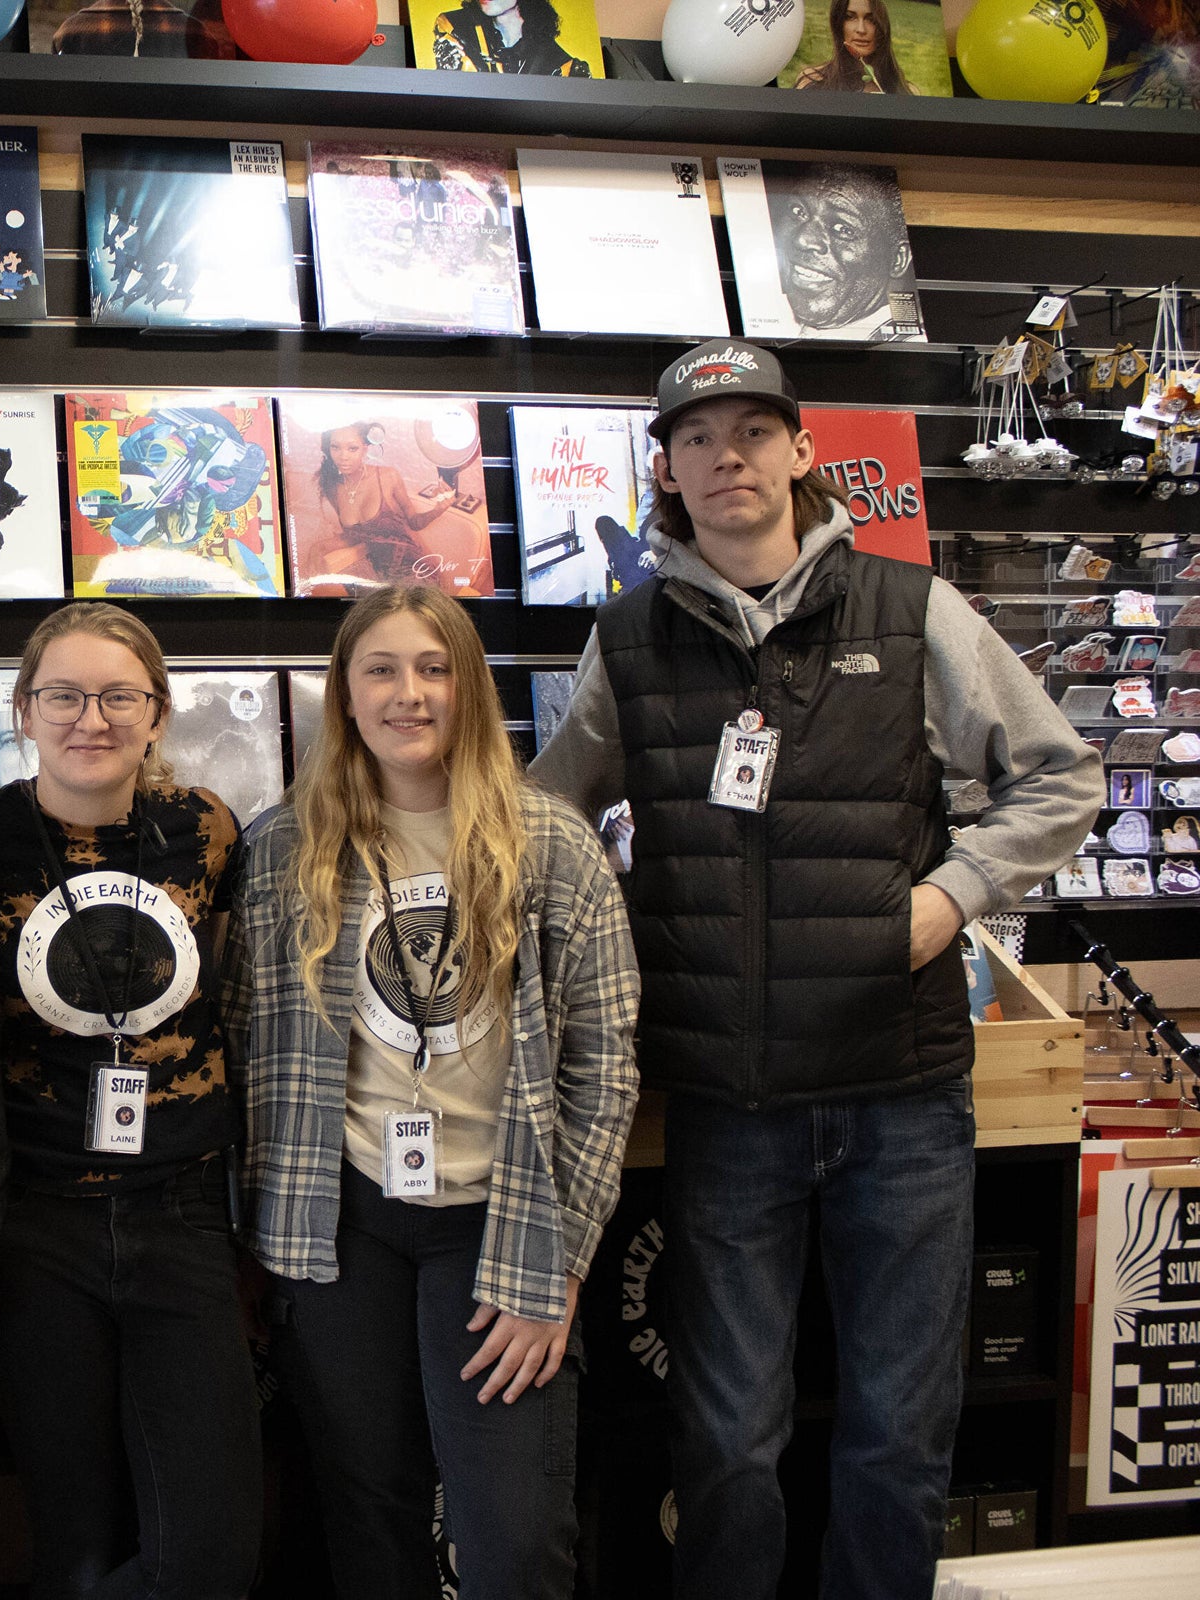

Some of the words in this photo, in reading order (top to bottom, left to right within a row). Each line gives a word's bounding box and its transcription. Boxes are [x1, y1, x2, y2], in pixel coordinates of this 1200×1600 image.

[724, 5, 758, 37] DAY
[1077, 15, 1100, 50] DAY
[236, 145, 250, 154] LEX
[252, 146, 275, 155] HIVES
[245, 155, 269, 163] ALBUM
[724, 162, 758, 170] HOWLIN'
[238, 164, 252, 172] THE
[254, 165, 277, 174] HIVES
[419, 200, 499, 226] union
[480, 227, 498, 235] buzz
[675, 346, 758, 384] Armadillo
[691, 374, 717, 391] Hat
[719, 373, 742, 385] Co.
[531, 462, 615, 494] HUNTER
[411, 553, 460, 579] Over
[1140, 605, 1152, 613] SO
[735, 737, 769, 755] STAFF
[727, 791, 756, 802] ETHAN
[46, 886, 94, 919] INDIE
[99, 883, 158, 907] EARTH
[35, 993, 71, 1023] PLANTS
[153, 976, 192, 1018] RECORDS
[356, 991, 386, 1031] PLANTS
[396, 1030, 456, 1045] CRYTALS
[111, 1077, 145, 1094] STAFF
[396, 1121, 430, 1137] STAFF
[111, 1135, 136, 1143] LAINE
[404, 1179, 427, 1187] ABBY
[986, 1269, 1012, 1278] CRUEL
[986, 1278, 1014, 1287] TUNES
[1140, 1323, 1175, 1347] LONE
[987, 1509, 1012, 1519] CRUEL
[988, 1518, 1014, 1527] TUNES
